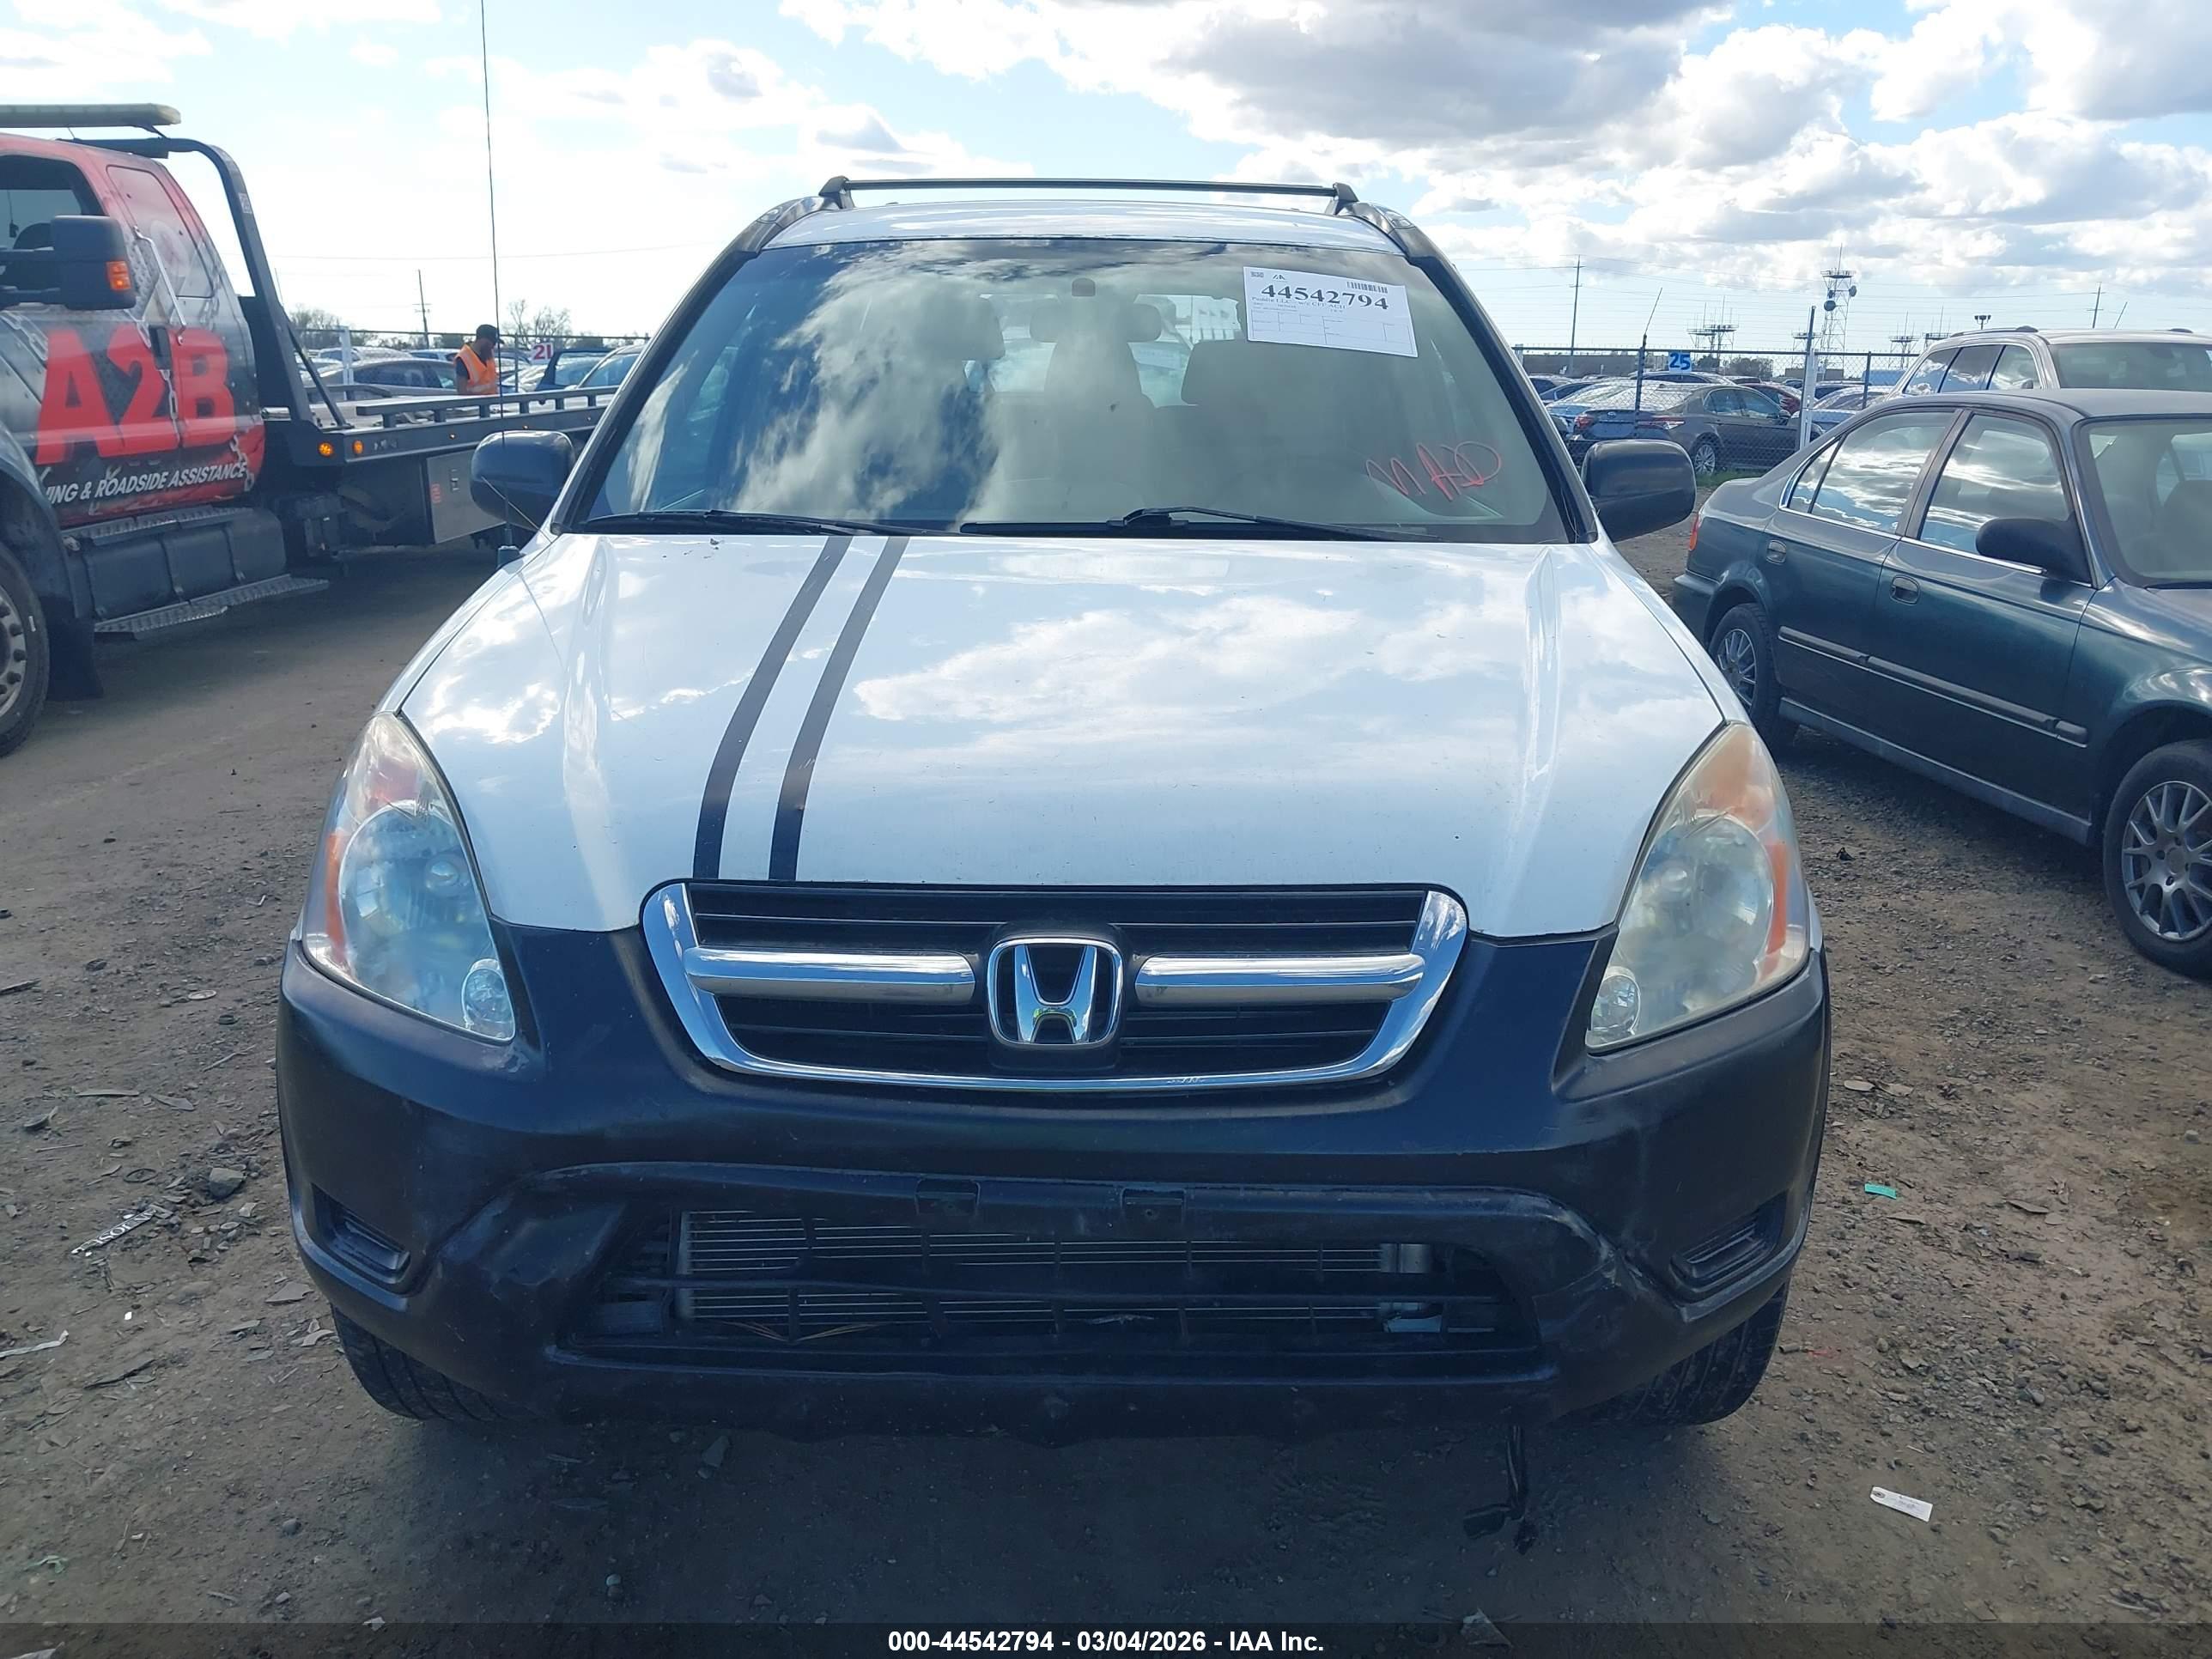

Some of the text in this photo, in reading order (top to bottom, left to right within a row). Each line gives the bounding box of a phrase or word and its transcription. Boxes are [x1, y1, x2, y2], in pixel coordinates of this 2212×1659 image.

[1261, 284, 1389, 310] 44542794
[533, 344, 552, 360] 21
[1668, 352, 1691, 370] 25
[36, 321, 235, 465] A2B
[46, 461, 247, 504] ING & ROADSIDE ASSISTANCE
